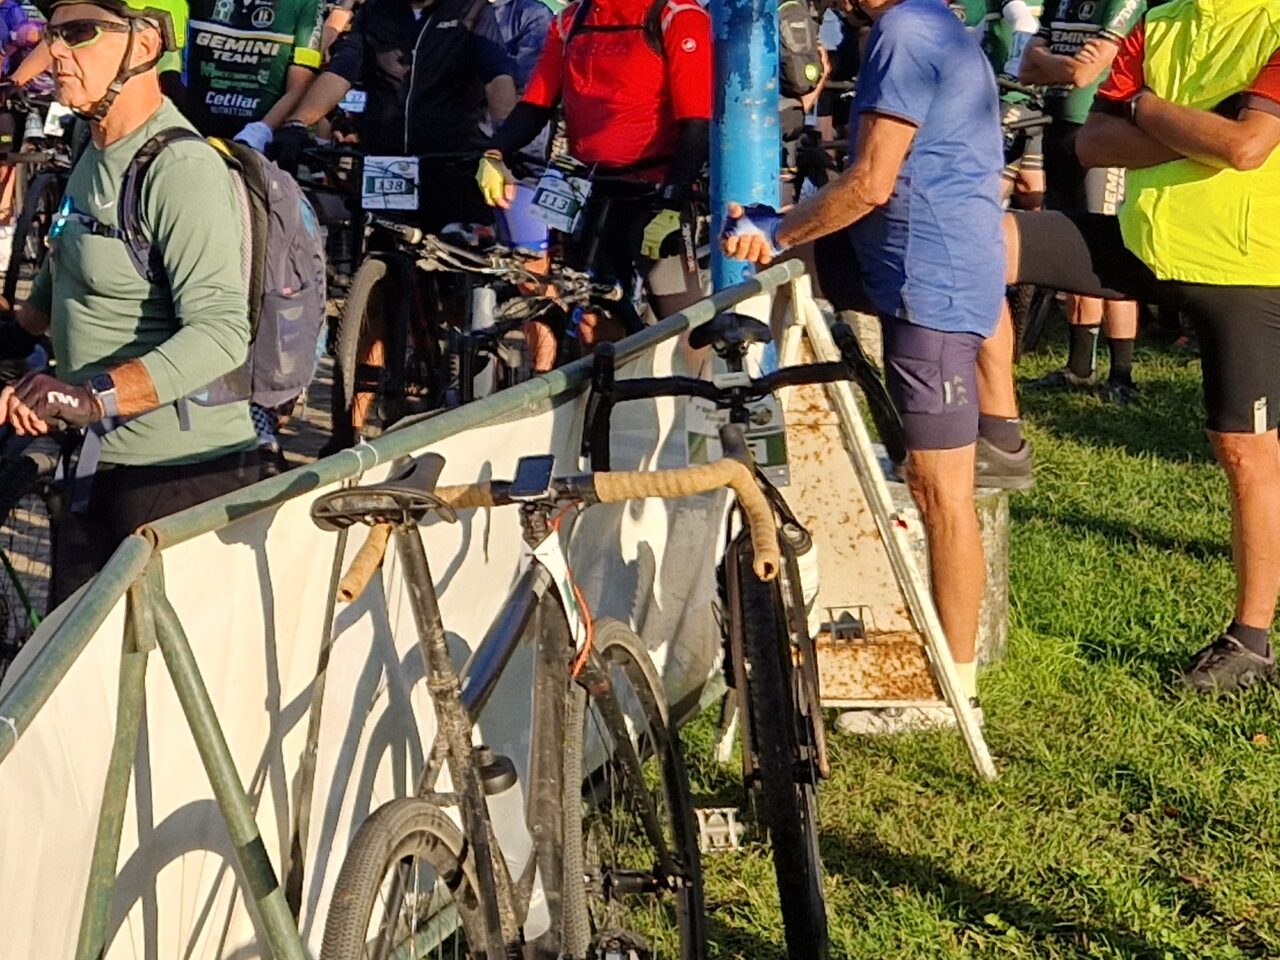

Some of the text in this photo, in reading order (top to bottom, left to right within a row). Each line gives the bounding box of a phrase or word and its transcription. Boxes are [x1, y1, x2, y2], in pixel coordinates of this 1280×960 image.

[195, 32, 280, 57] GEMINI
[212, 50, 258, 64] TEAM
[205, 91, 261, 109] Cetilar
[376, 182, 403, 191] 138
[541, 194, 568, 210] 113
